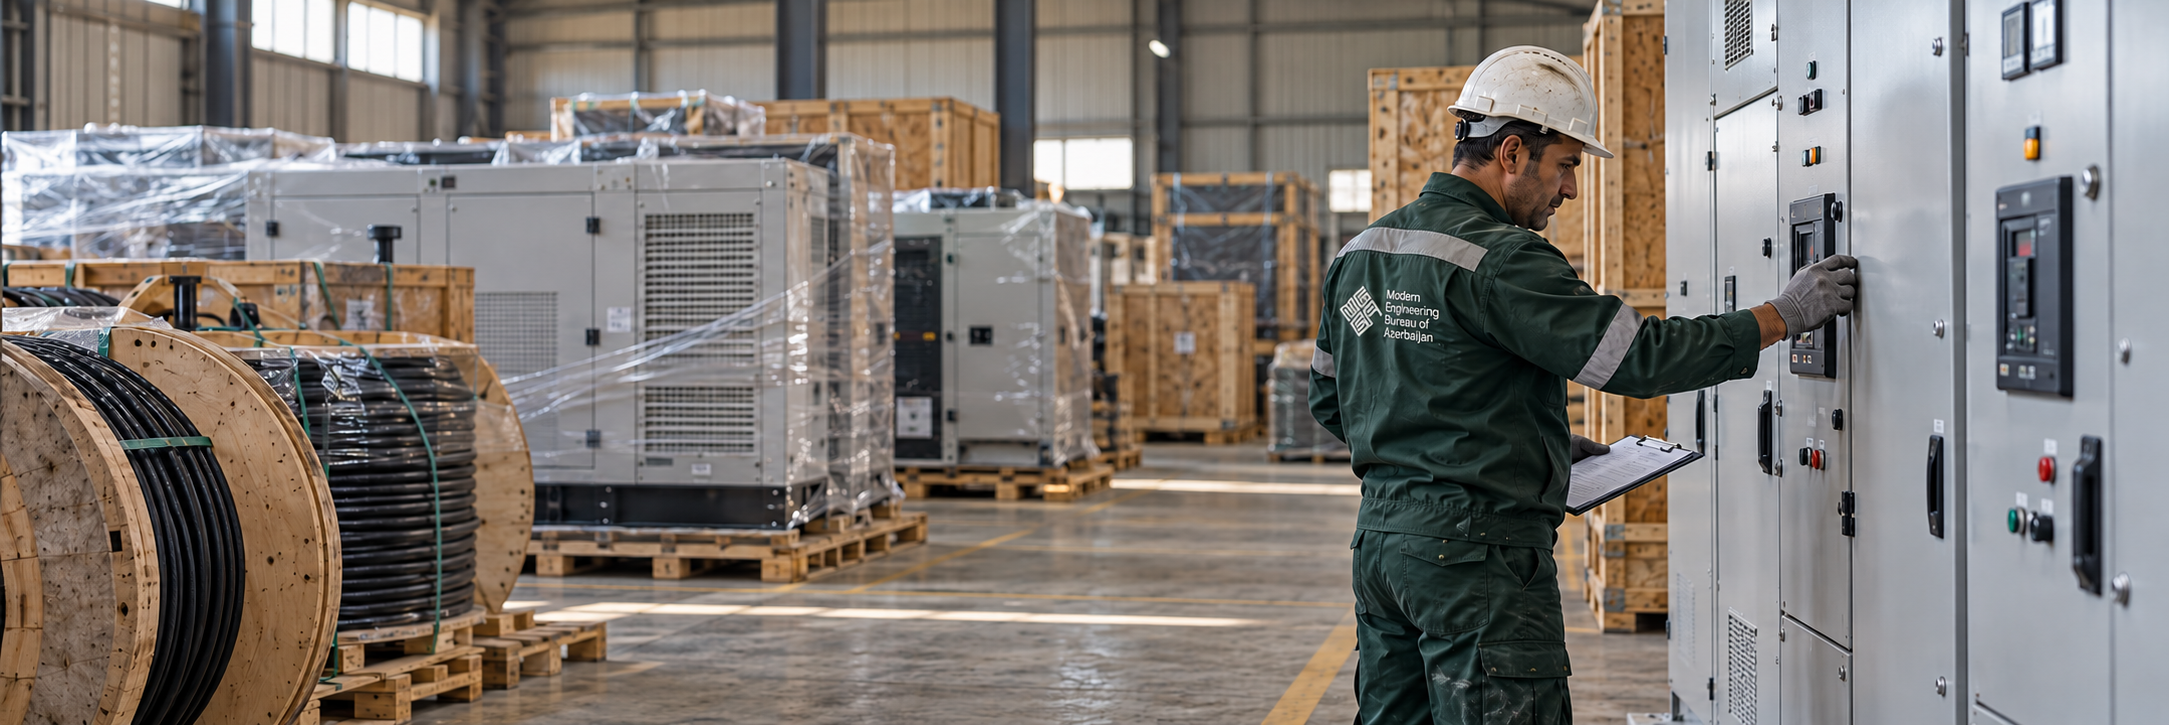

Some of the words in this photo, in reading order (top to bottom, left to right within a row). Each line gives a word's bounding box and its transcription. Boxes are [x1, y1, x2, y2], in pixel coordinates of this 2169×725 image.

[1386, 289, 1421, 303] Modern
[1385, 302, 1439, 320] Engineering
[1384, 314, 1417, 328] Bureau
[1419, 318, 1430, 329] of
[1383, 327, 1434, 344] Azerbaijan
